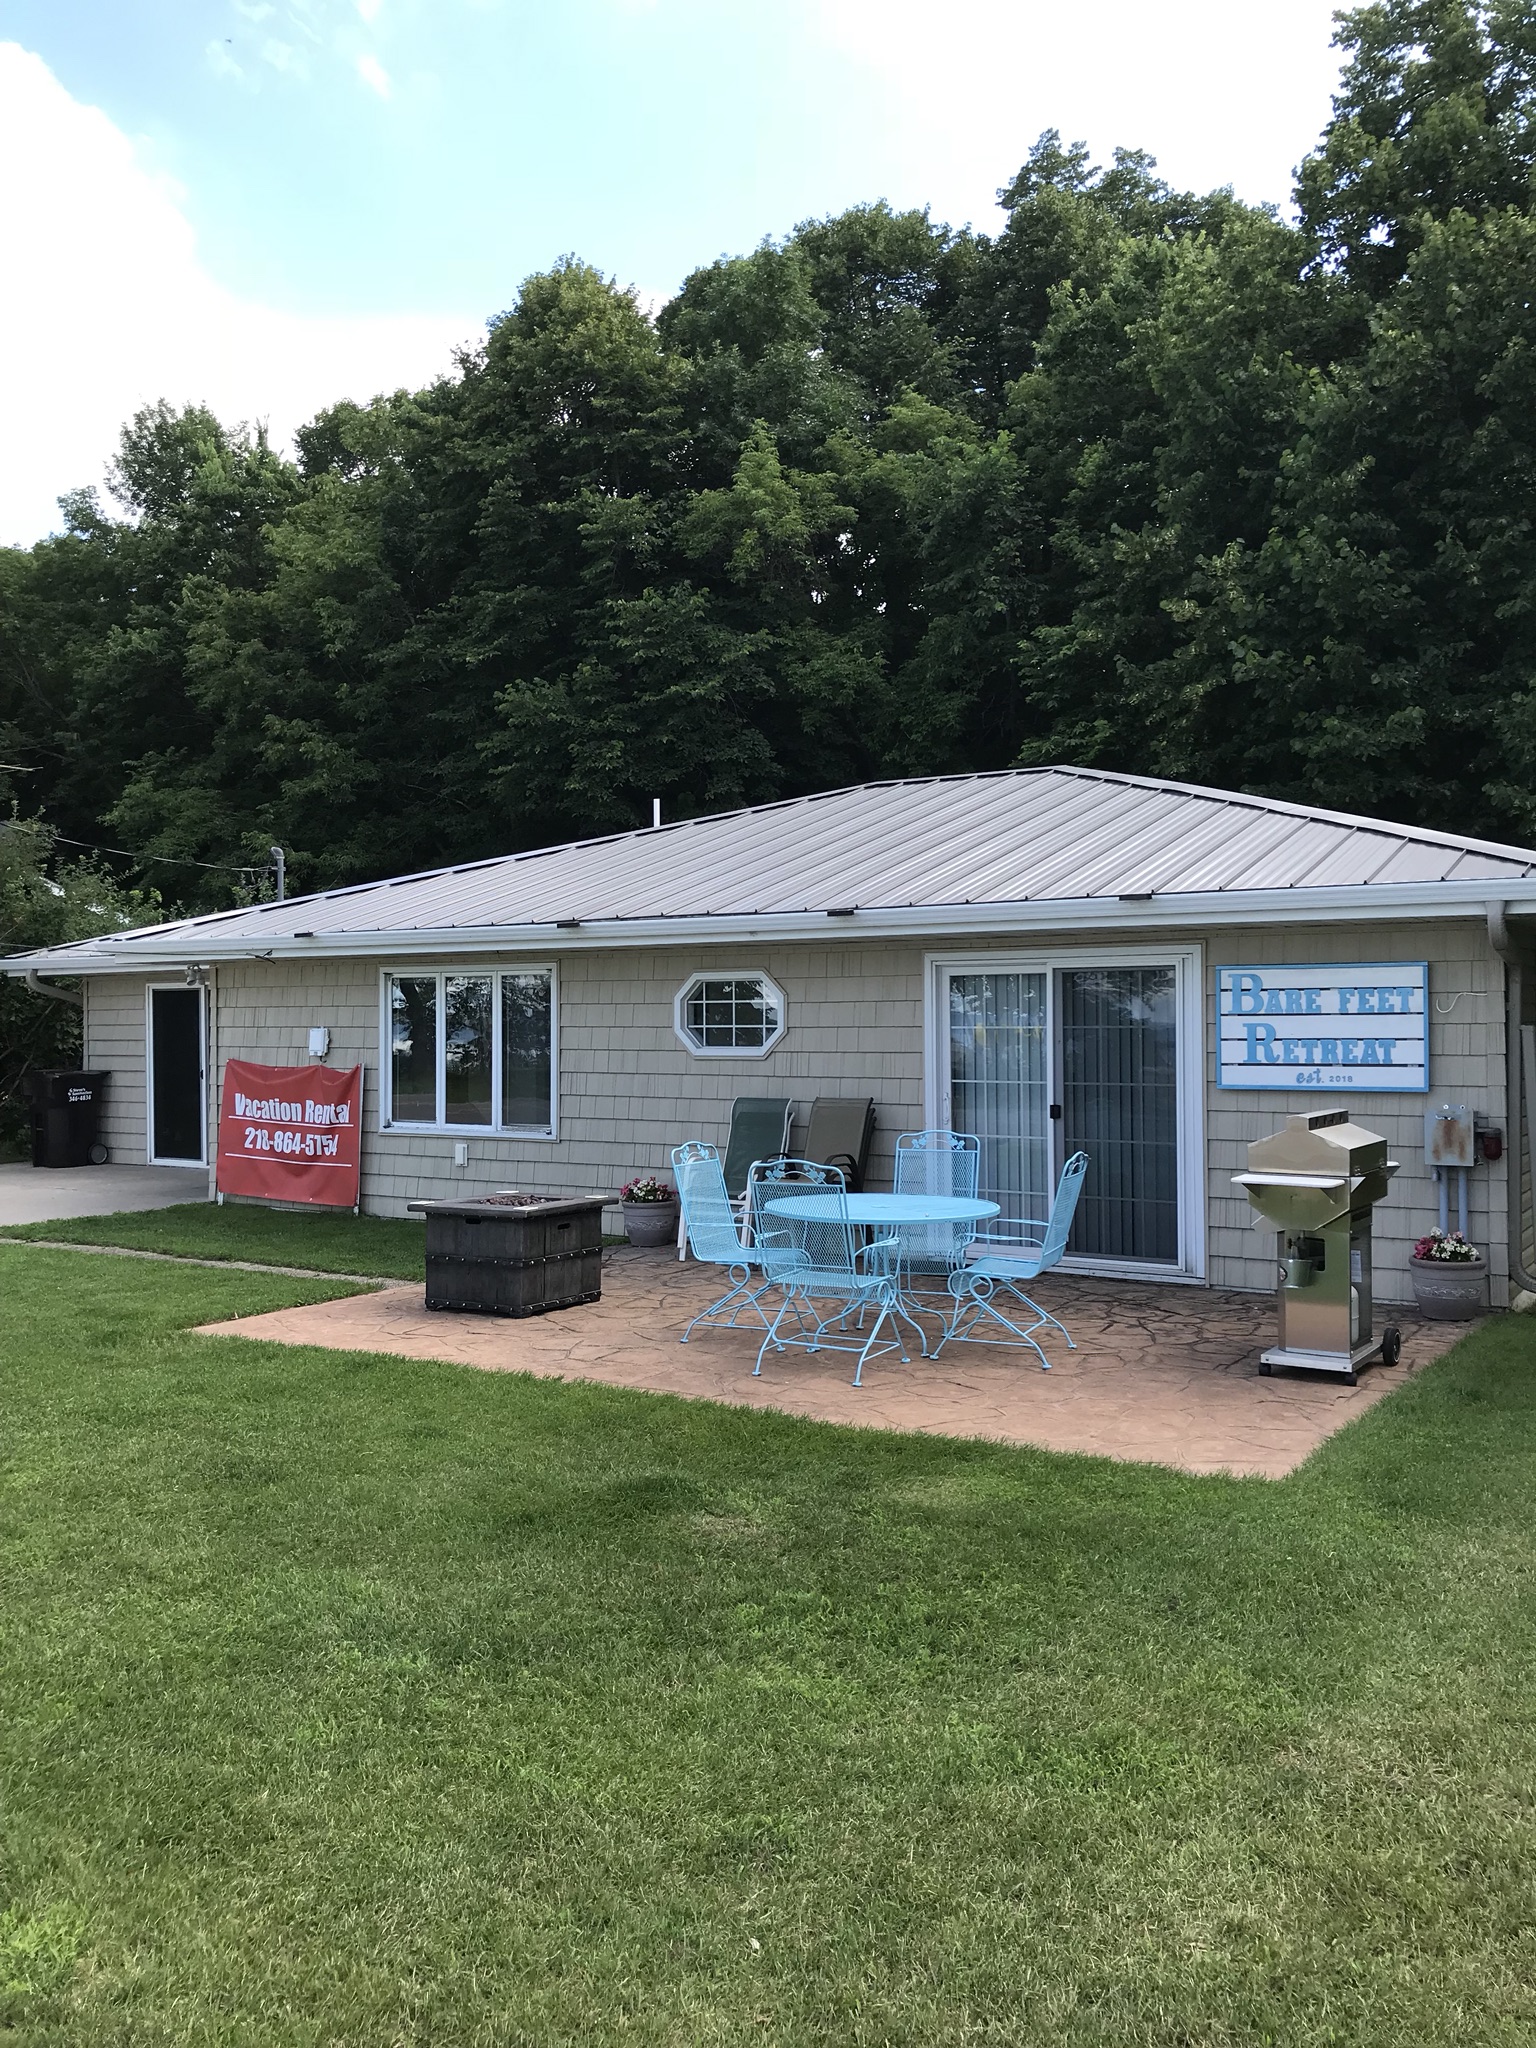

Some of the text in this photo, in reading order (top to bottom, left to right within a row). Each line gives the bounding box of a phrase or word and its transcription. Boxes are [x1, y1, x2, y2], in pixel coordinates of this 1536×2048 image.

[1228, 973, 1414, 1014] BARE FEET
[1242, 1023, 1396, 1064] RETREAT
[1296, 1068, 1353, 1084] est. 2018
[235, 1093, 351, 1125] Vacation Rental
